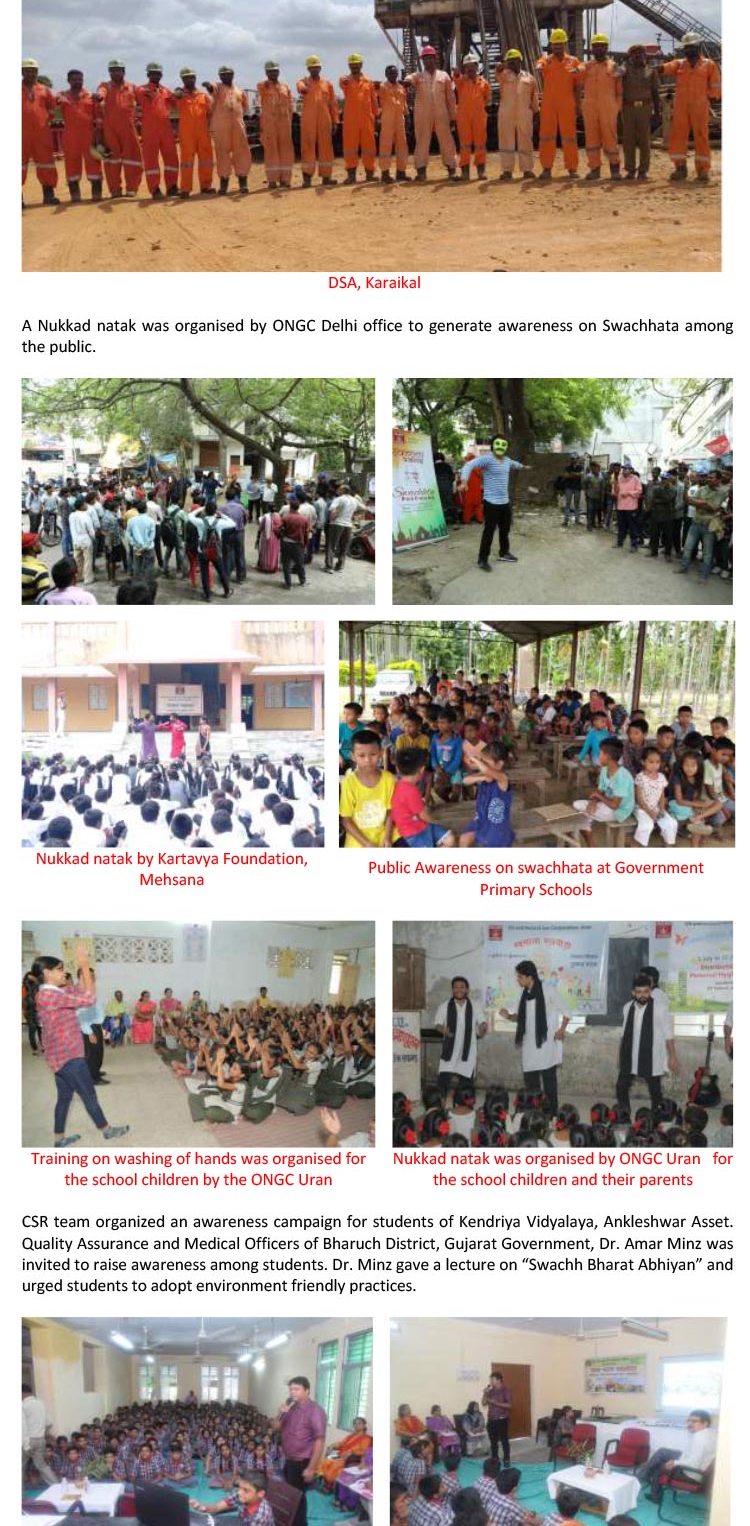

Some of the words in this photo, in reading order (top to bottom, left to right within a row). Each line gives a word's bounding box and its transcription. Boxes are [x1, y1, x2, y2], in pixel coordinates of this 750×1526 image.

[329, 276, 360, 291] DSA,
[366, 276, 420, 289] Karaikal
[37, 852, 89, 865] Nukkad
[94, 852, 132, 864] natak
[138, 852, 154, 867] by
[159, 853, 218, 867] Kartavya
[224, 852, 307, 867] Foundation,
[140, 873, 204, 886] Mehsana
